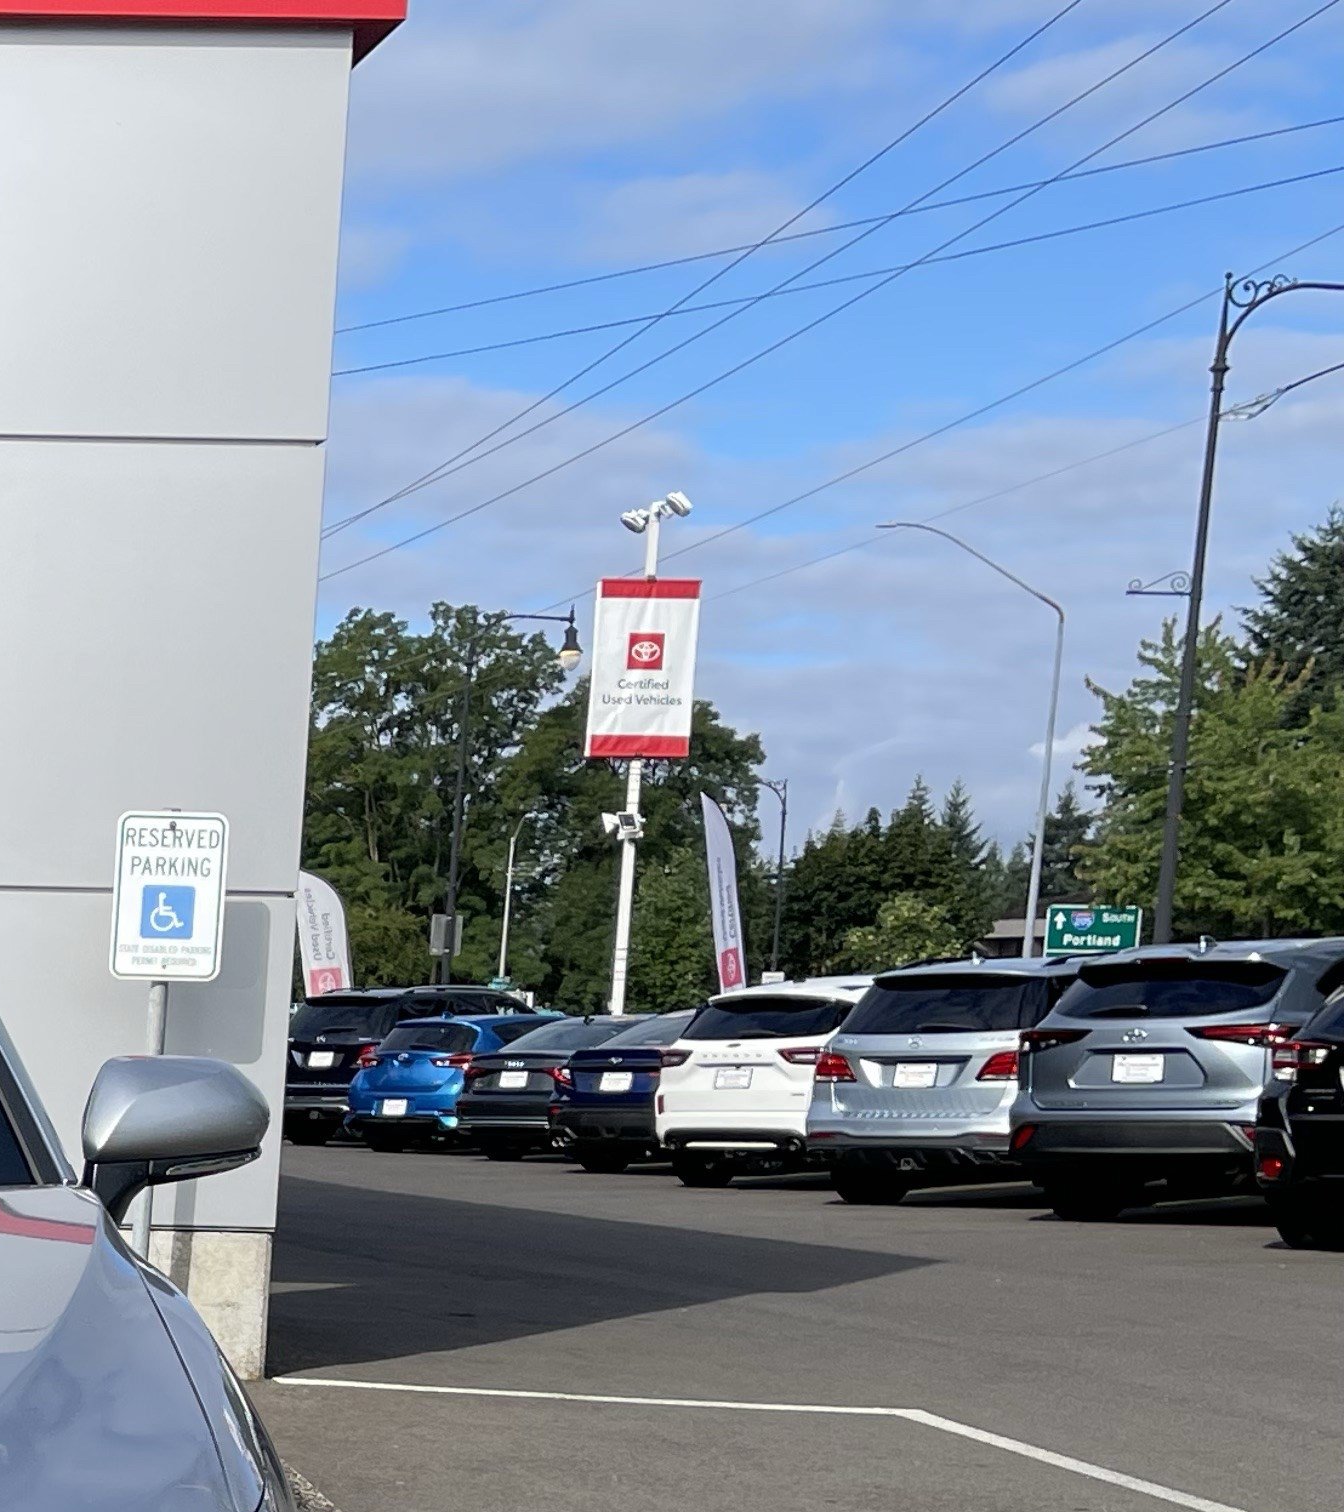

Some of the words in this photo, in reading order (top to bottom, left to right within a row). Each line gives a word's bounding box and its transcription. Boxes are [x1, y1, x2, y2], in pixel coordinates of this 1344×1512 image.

[617, 679, 670, 690] Certified
[602, 694, 633, 705] Used
[635, 694, 682, 706] Vehicles
[125, 828, 221, 849] RESERVED
[130, 856, 212, 878] PARKING
[1062, 933, 1121, 946] Portland
